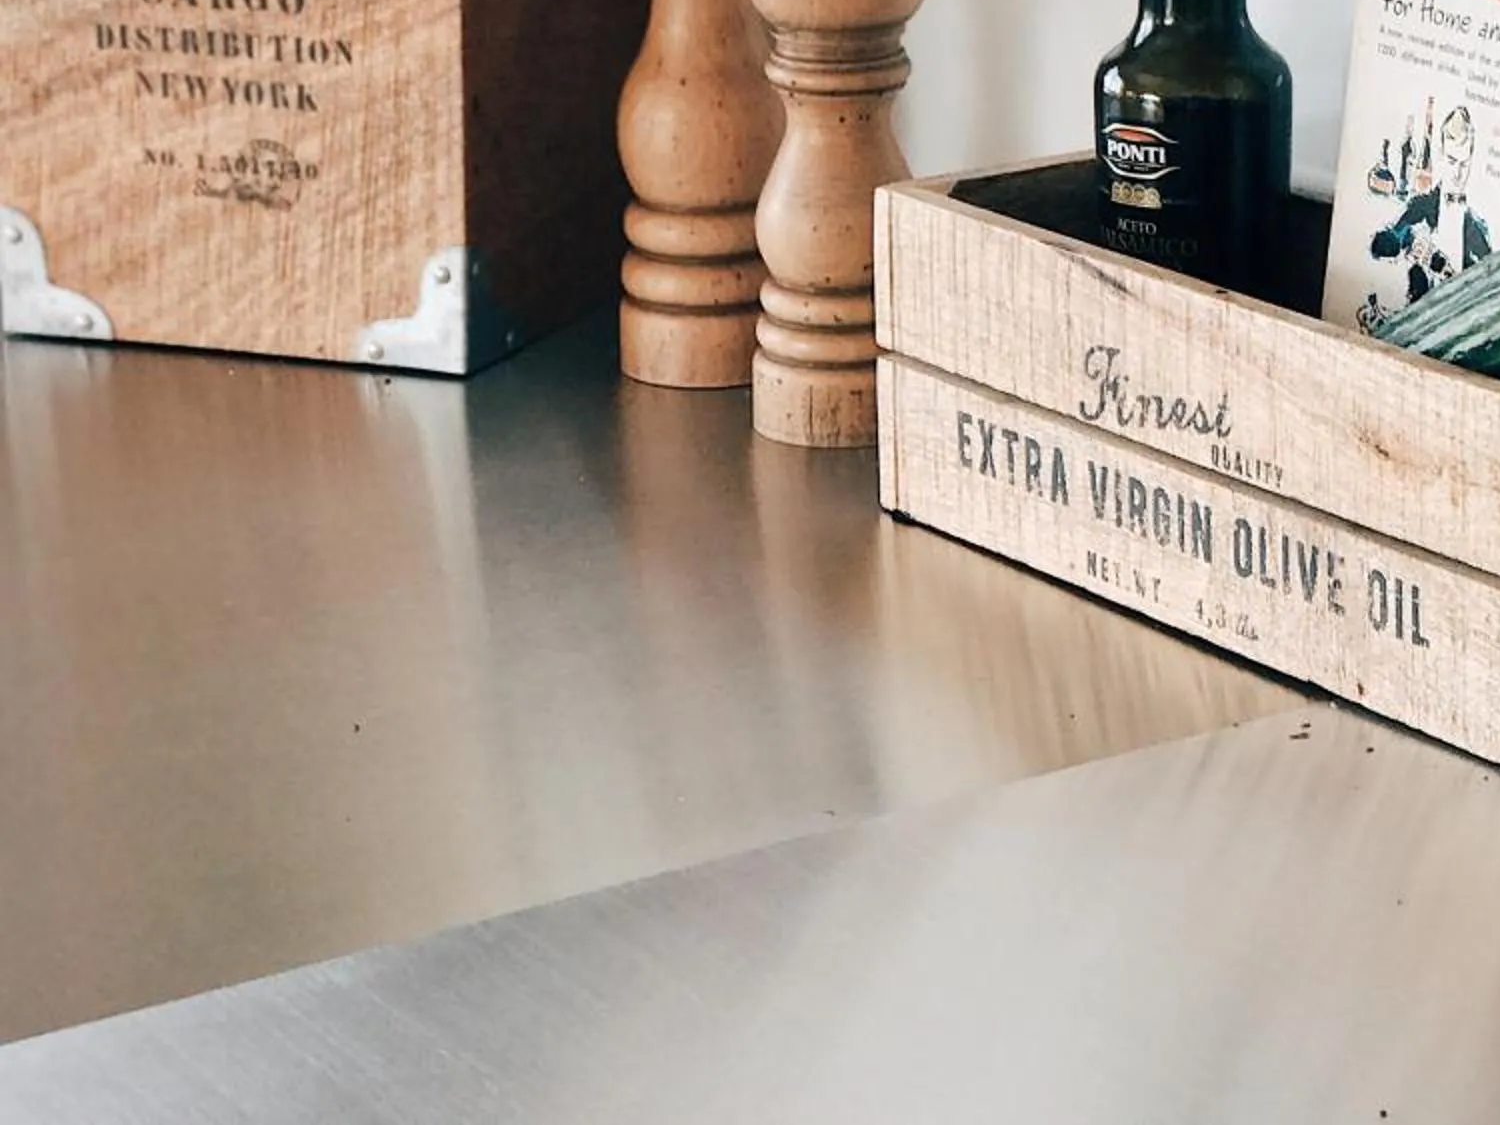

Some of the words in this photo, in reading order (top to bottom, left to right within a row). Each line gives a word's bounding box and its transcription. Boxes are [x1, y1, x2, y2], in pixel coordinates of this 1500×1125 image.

[95, 23, 354, 65] DISTRIBUTION
[135, 70, 208, 101] NEW
[221, 76, 319, 113] YORK
[1107, 138, 1166, 164] PONTI
[1117, 216, 1157, 236] ACETO
[1080, 345, 1233, 439] Finest
[1211, 444, 1285, 489] QUALITY
[956, 410, 1069, 506] EXTRA
[1087, 459, 1214, 565] VIRGIN
[1232, 517, 1346, 615] OLIVE
[1367, 568, 1431, 649] OIL
